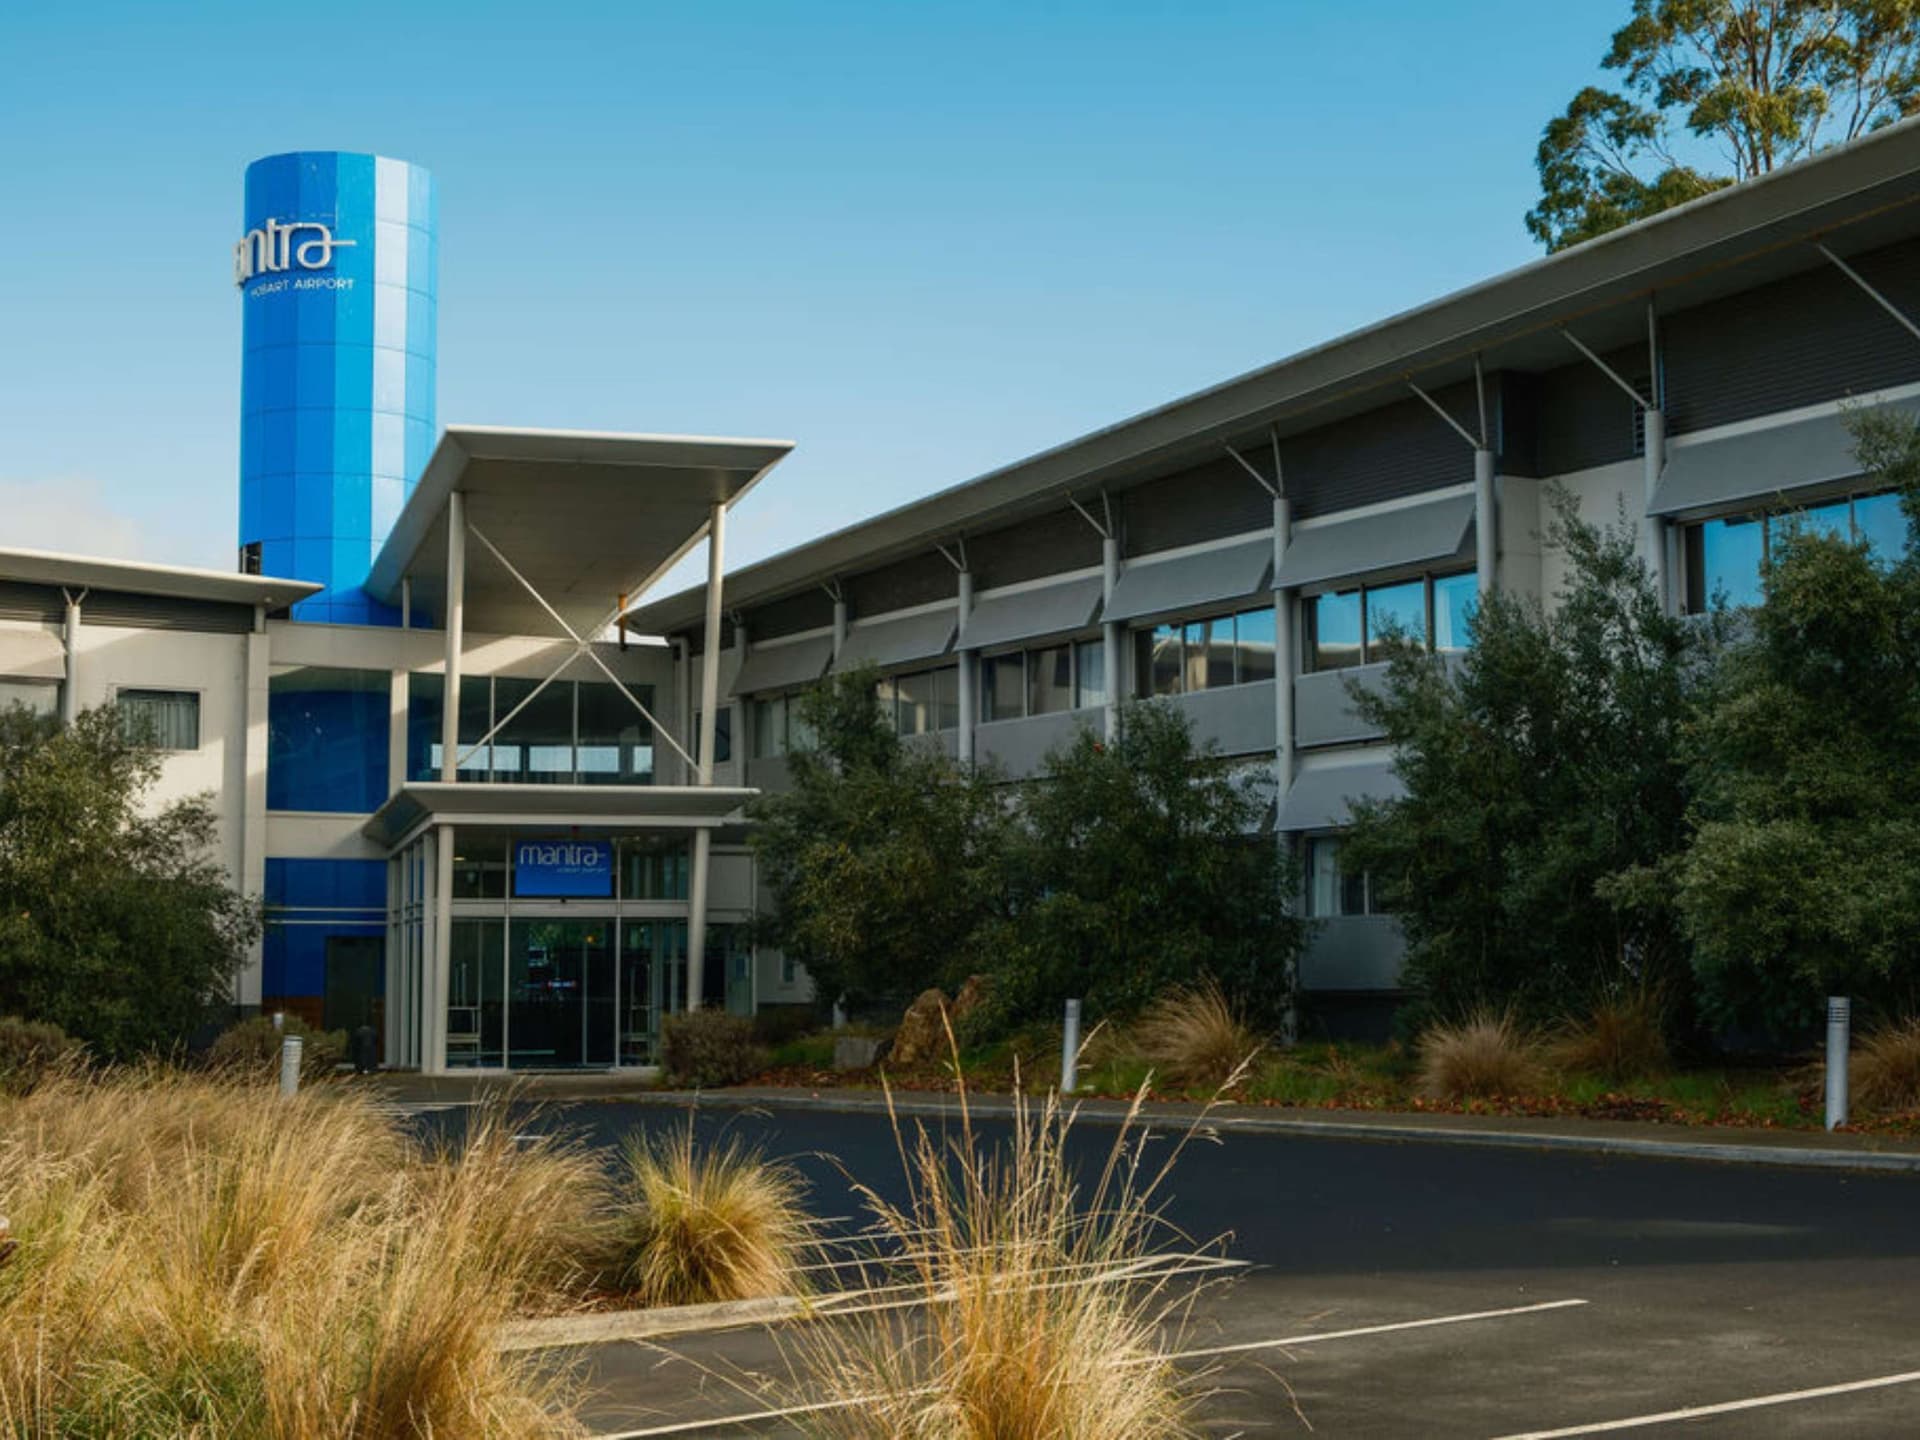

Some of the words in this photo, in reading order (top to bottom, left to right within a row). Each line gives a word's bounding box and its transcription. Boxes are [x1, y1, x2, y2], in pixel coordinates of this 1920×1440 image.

[232, 218, 357, 284] ntra
[294, 278, 355, 290] AIRPORT
[520, 845, 606, 866] mantra
